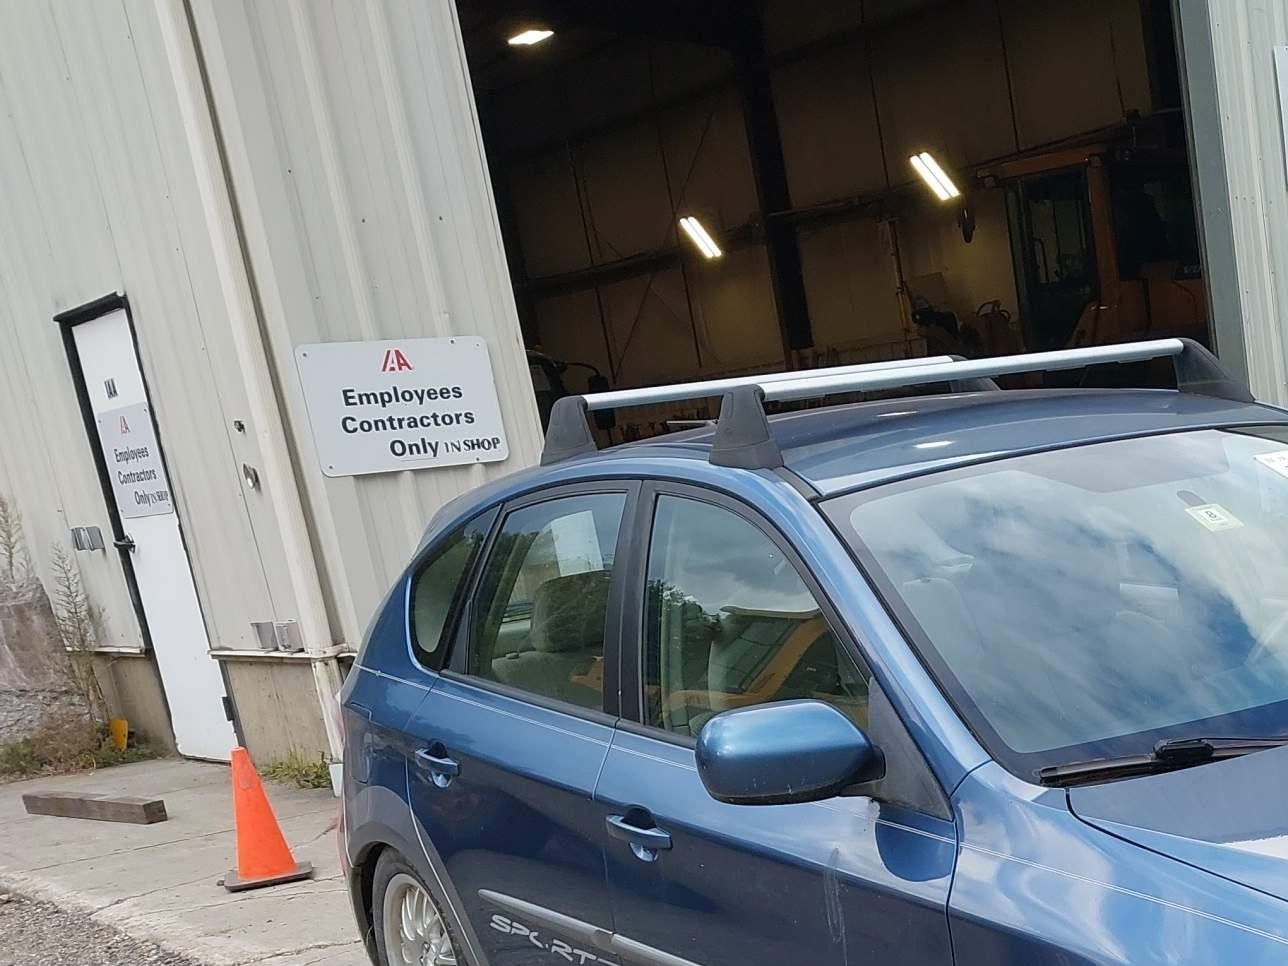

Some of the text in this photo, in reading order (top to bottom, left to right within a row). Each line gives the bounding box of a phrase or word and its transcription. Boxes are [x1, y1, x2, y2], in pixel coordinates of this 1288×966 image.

[104, 378, 118, 399] IAA
[342, 386, 463, 408] Employees
[341, 411, 475, 434] Contractors
[114, 446, 149, 464] Employees
[389, 437, 500, 457] Only IN SHOP
[117, 469, 157, 485] Contractors
[134, 490, 151, 507] Only
